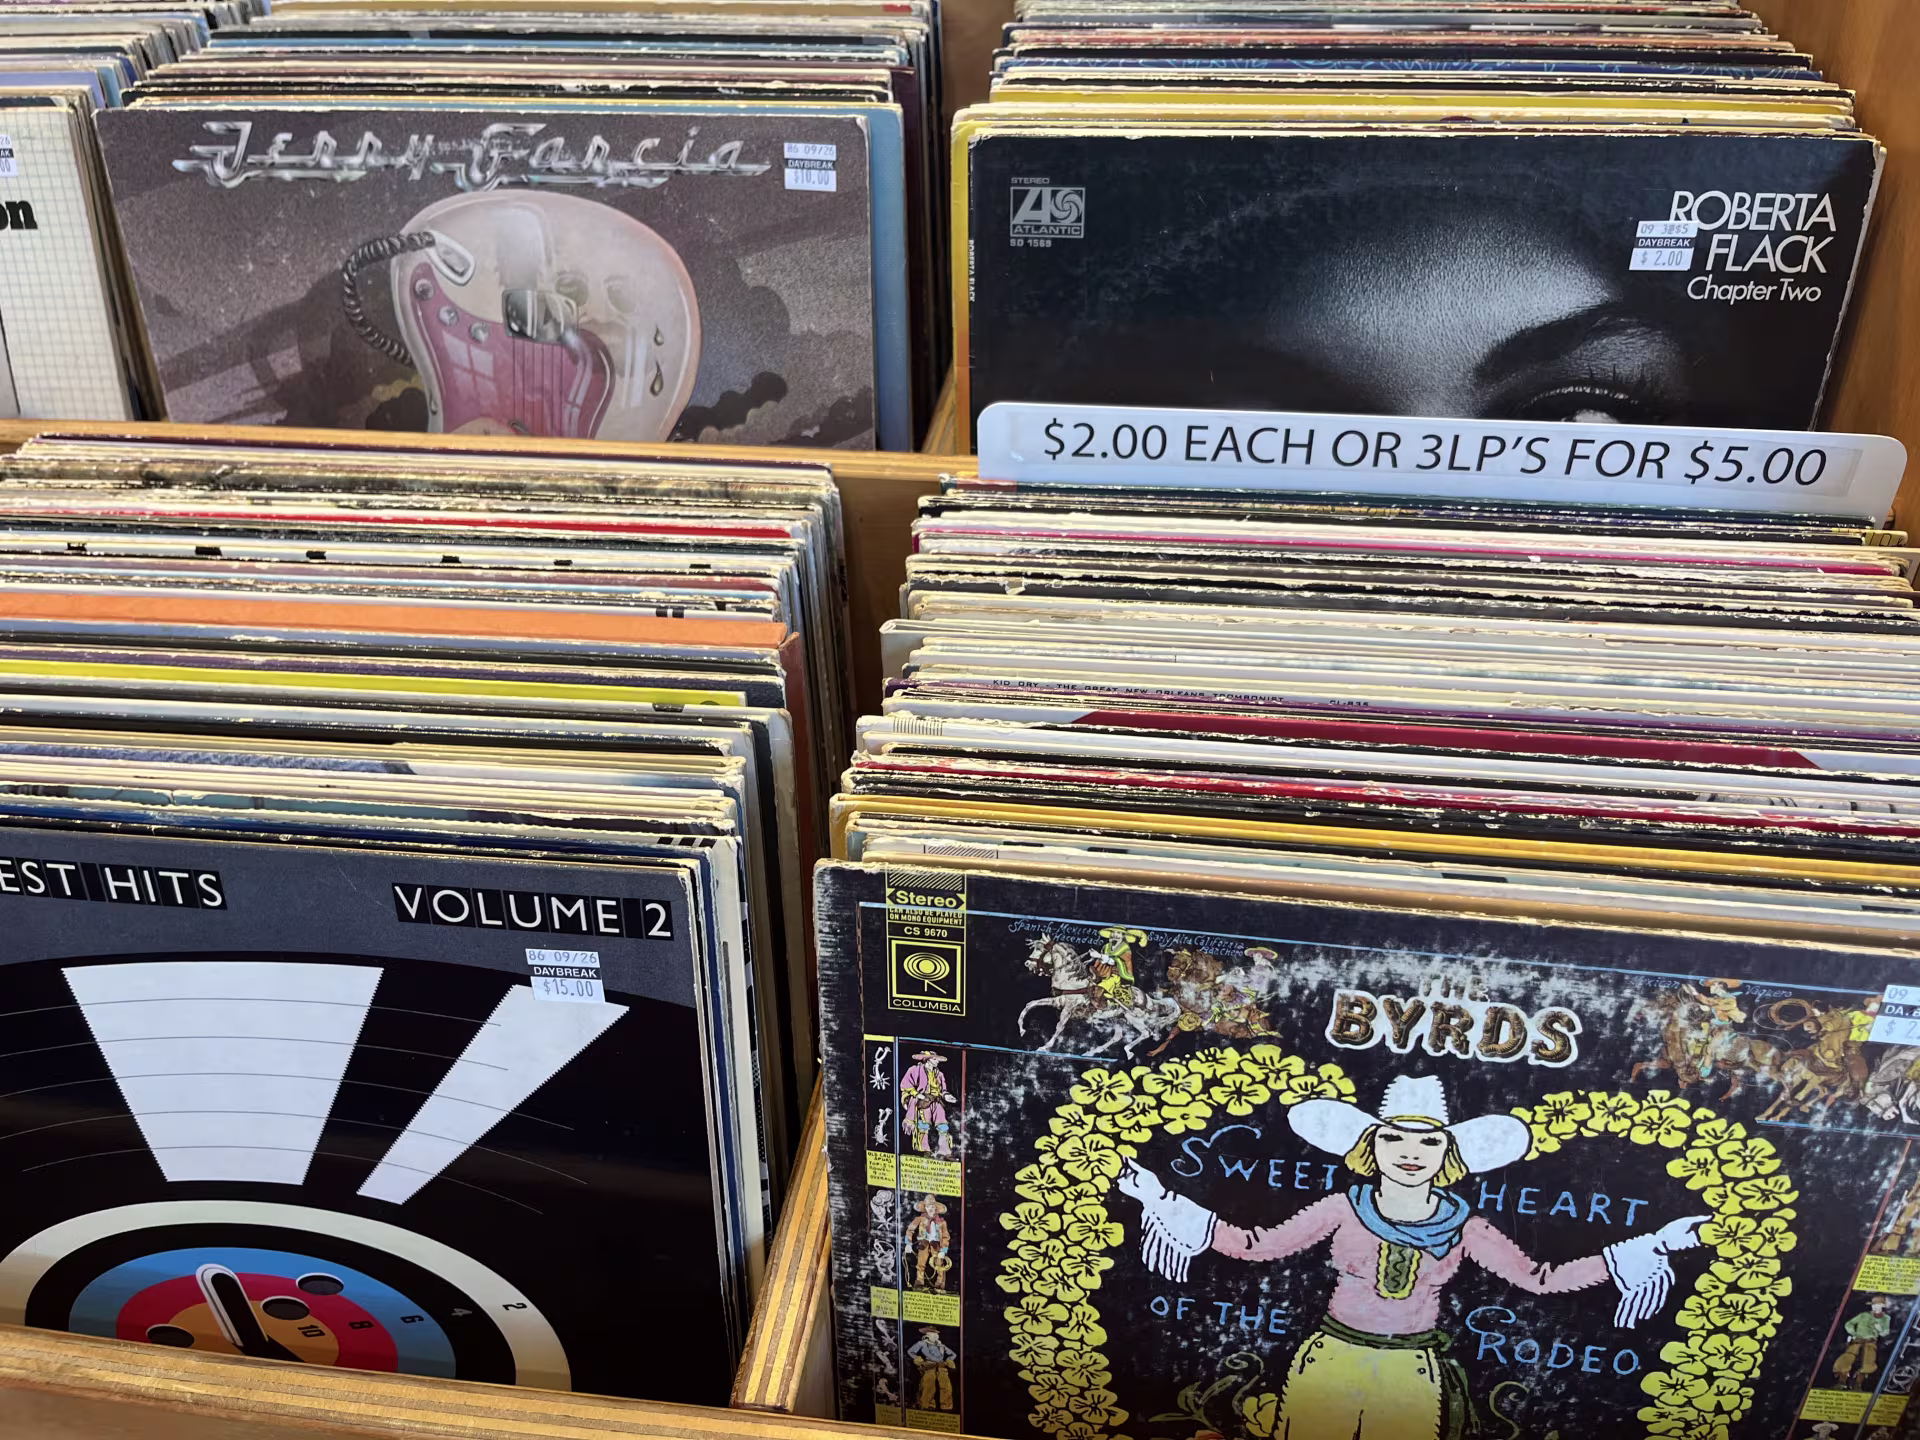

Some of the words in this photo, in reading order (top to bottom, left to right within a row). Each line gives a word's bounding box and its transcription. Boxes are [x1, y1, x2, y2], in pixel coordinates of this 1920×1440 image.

[172, 120, 435, 188] Jerry
[464, 122, 772, 191] Garcia
[788, 159, 834, 169] DAYBREAK
[794, 170, 830, 185] $10.00
[1669, 190, 1836, 232] ROBERTA
[1014, 225, 1081, 235] ATLANTIC
[1640, 224, 1654, 235] 09
[1010, 239, 1024, 247] SD
[1638, 238, 1691, 247] DAYBREAK
[1654, 250, 1683, 266] 2.00
[1705, 233, 1834, 273] FLACK
[1687, 274, 1777, 305] Chapter
[1779, 278, 1822, 301] Two
[1044, 418, 1167, 460] $2.00
[1184, 425, 1314, 465] EACH
[1331, 430, 1401, 468] OR
[1415, 433, 1549, 475] 3LP'S
[1564, 438, 1670, 480] FOR
[1683, 439, 1827, 486] $5.00
[0, 859, 76, 896] EST
[104, 867, 223, 907] HITS
[896, 890, 957, 908] Stereo
[395, 886, 620, 933] VOLUME
[645, 903, 671, 937] 2
[900, 914, 921, 922] MONO
[922, 916, 963, 925] EQUIPMENT
[936, 910, 963, 918] PLAYED
[904, 926, 920, 936] CS
[924, 928, 948, 938] 9670
[528, 950, 545, 961] 86
[554, 951, 597, 964] 09/26
[533, 966, 597, 978] DAYBREAK
[543, 978, 594, 997] $15.00
[893, 999, 961, 1012] COLUMBIA
[1328, 991, 1580, 1065] BYRDS
[1478, 1181, 1648, 1226] HEART
[1150, 1296, 1195, 1320] OF
[1213, 1301, 1286, 1334] THE
[1466, 1306, 1640, 1374] RODEO
